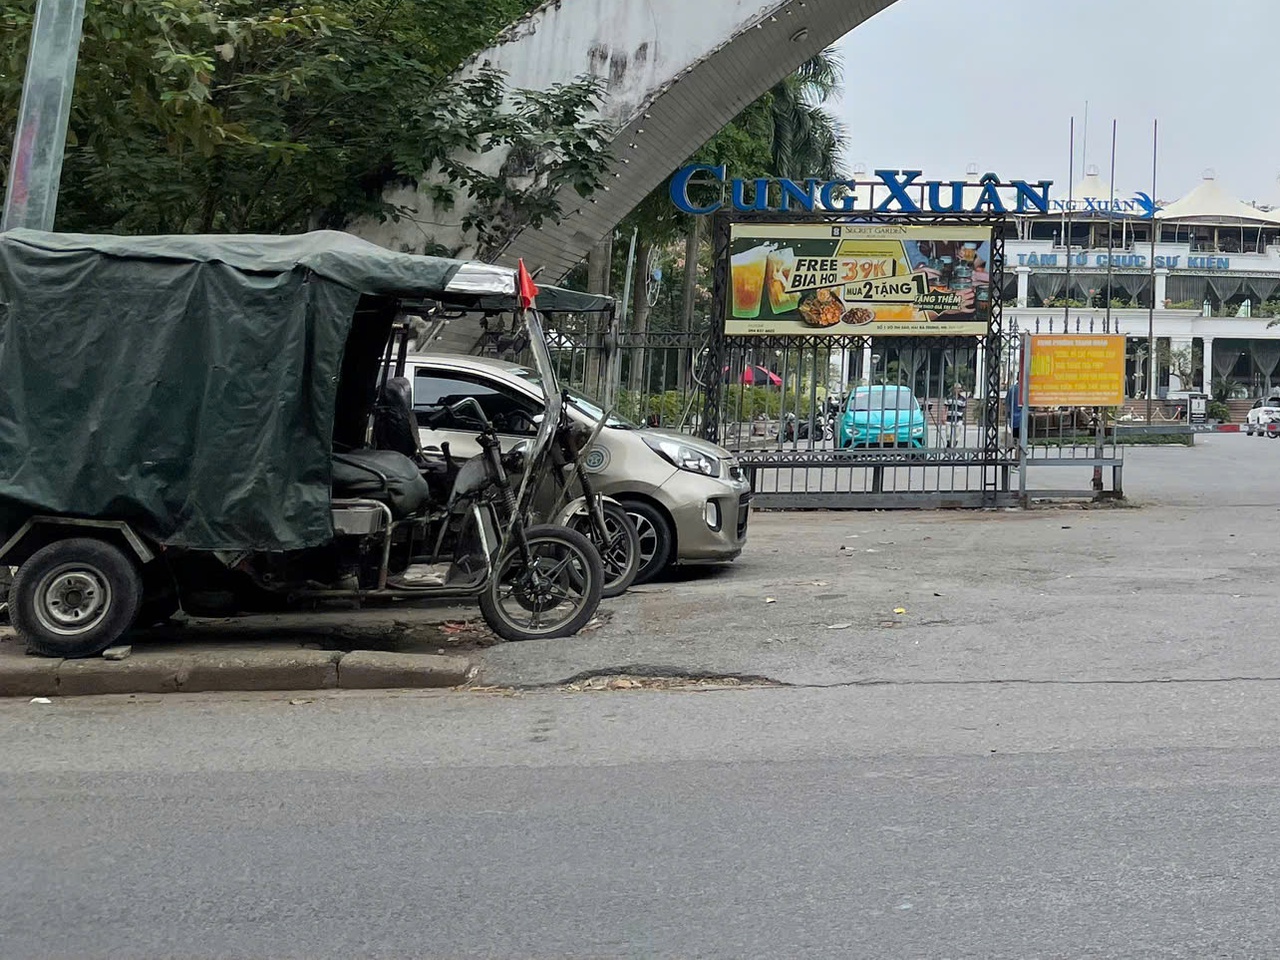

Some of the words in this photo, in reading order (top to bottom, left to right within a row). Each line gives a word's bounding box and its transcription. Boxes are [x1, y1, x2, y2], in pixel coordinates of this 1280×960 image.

[669, 163, 858, 215] CUNG
[874, 169, 1053, 215] XUÂN
[795, 258, 838, 272] FREE
[1017, 251, 1057, 267] TÂM
[841, 258, 887, 281] 39K
[791, 273, 817, 289] BIA
[846, 287, 863, 296] MUA
[863, 281, 873, 299] 2
[874, 281, 912, 298] TẶNG
[911, 274, 925, 295] 1
[937, 293, 962, 304] THÊM
